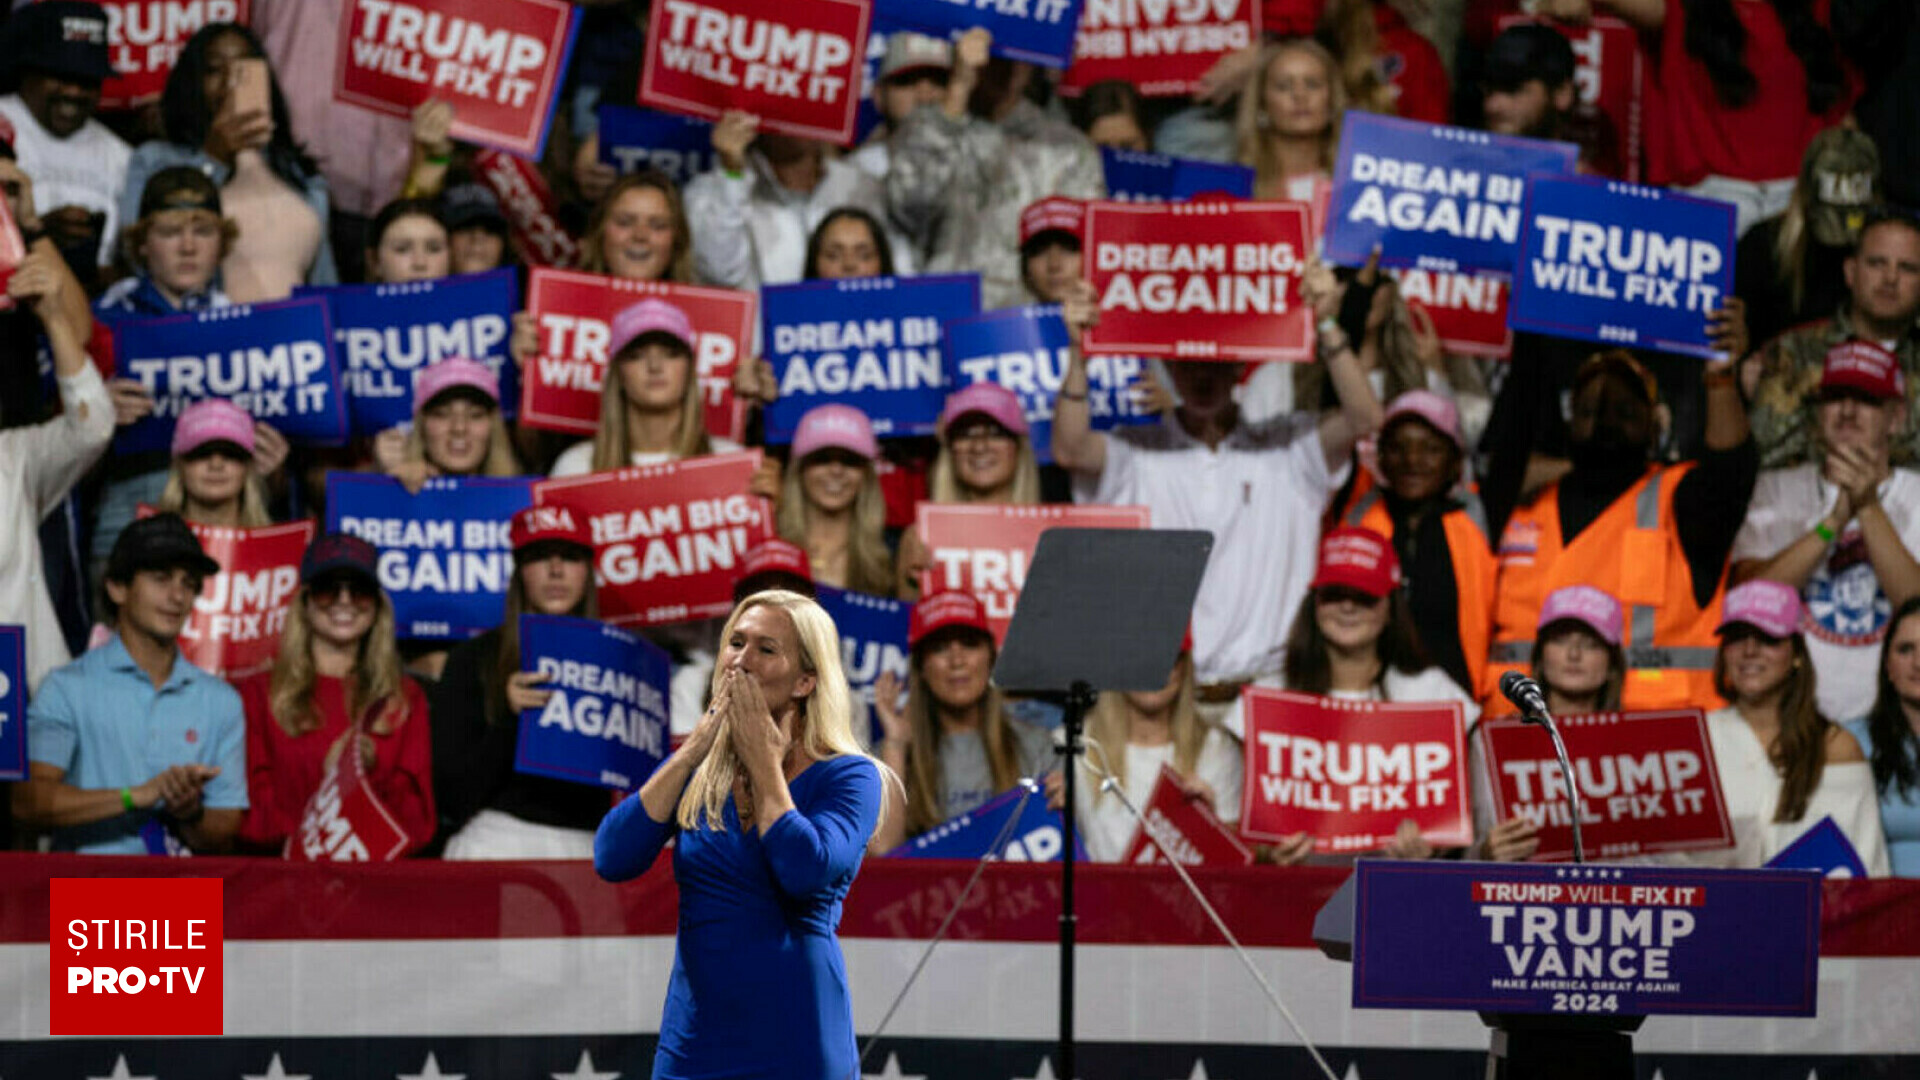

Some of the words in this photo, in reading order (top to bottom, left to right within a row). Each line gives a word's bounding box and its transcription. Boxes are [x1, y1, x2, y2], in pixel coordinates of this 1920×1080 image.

[107, 1, 237, 44] RUMP
[358, 0, 546, 75] TRUMP
[664, 0, 851, 76] TRUMP
[352, 38, 428, 84] WILL
[433, 59, 494, 99] FIX
[496, 77, 536, 108] IT
[660, 39, 739, 86] WILL
[744, 61, 802, 98] FIX
[807, 75, 845, 103] IT
[1352, 154, 1478, 199] DREAM
[1486, 173, 1523, 202] BI
[1348, 186, 1523, 244] AGAIN
[1097, 243, 1226, 272] DREAM
[1233, 243, 1304, 276] BIG,
[1535, 215, 1722, 282] TRUMP
[1101, 273, 1290, 314] AGAIN!
[1532, 259, 1616, 299] WILL
[1623, 274, 1680, 307] FIX
[1686, 282, 1720, 313] IT
[335, 313, 507, 370] RUMP
[541, 314, 736, 376] TRP
[774, 319, 895, 354] DREAM
[902, 317, 940, 346] BI
[128, 340, 326, 396] TRUMP
[538, 358, 602, 392] WIL
[779, 348, 946, 396] AGAIN
[296, 382, 328, 414] IT
[524, 506, 576, 533] USA
[688, 495, 761, 530] BIG,
[377, 550, 516, 594] GAIN!
[596, 527, 748, 587] GAIN!
[193, 565, 298, 614] UMP
[210, 613, 262, 642] FIX
[536, 657, 636, 703] DREAM
[1259, 732, 1451, 785] TRUMP
[1503, 751, 1700, 801] TRUMP
[1260, 774, 1341, 811] WILL
[1350, 784, 1410, 811] FIX
[1416, 779, 1451, 807] IT
[1511, 799, 1603, 828] WILL
[1607, 793, 1667, 822] FIX
[1672, 788, 1706, 815] IT
[1482, 884, 1562, 902] TRUMP
[1568, 886, 1625, 904] WILL
[1631, 887, 1668, 904] FIX
[1674, 887, 1696, 905] IT
[1480, 905, 1696, 947] TRUMP
[1503, 946, 1670, 979] VANCE
[1492, 979, 1527, 990] MAKE
[1531, 980, 1588, 991] AMERICA
[1592, 981, 1632, 992] GREAT
[1636, 981, 1680, 992] AGAIN!
[1552, 993, 1619, 1012] 2024
